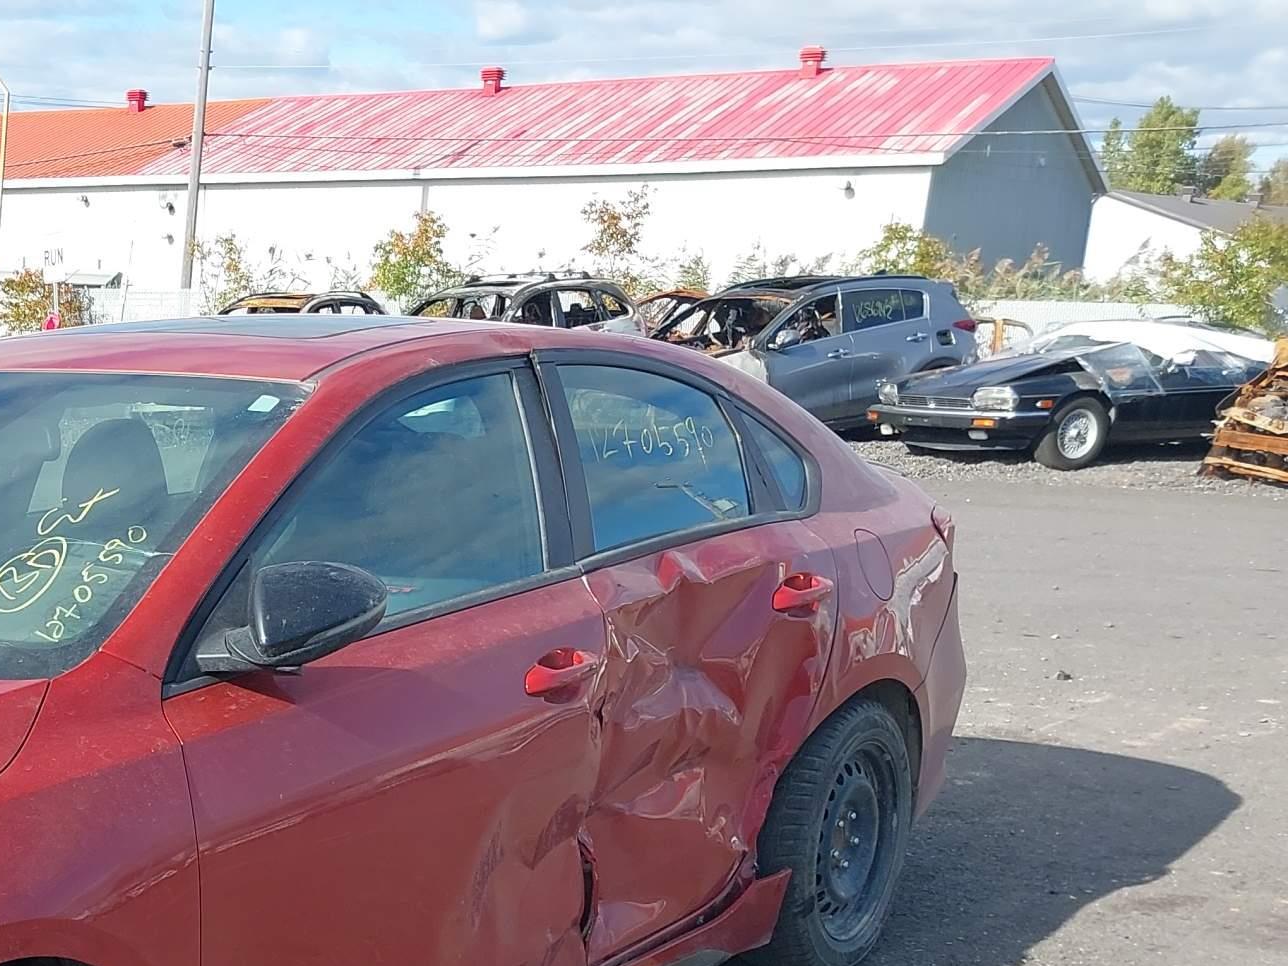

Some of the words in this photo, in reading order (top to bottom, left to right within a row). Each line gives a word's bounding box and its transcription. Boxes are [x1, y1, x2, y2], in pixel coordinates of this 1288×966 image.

[43, 248, 64, 267] RUN
[587, 416, 714, 466] 12705590
[34, 525, 148, 643] 12705590
